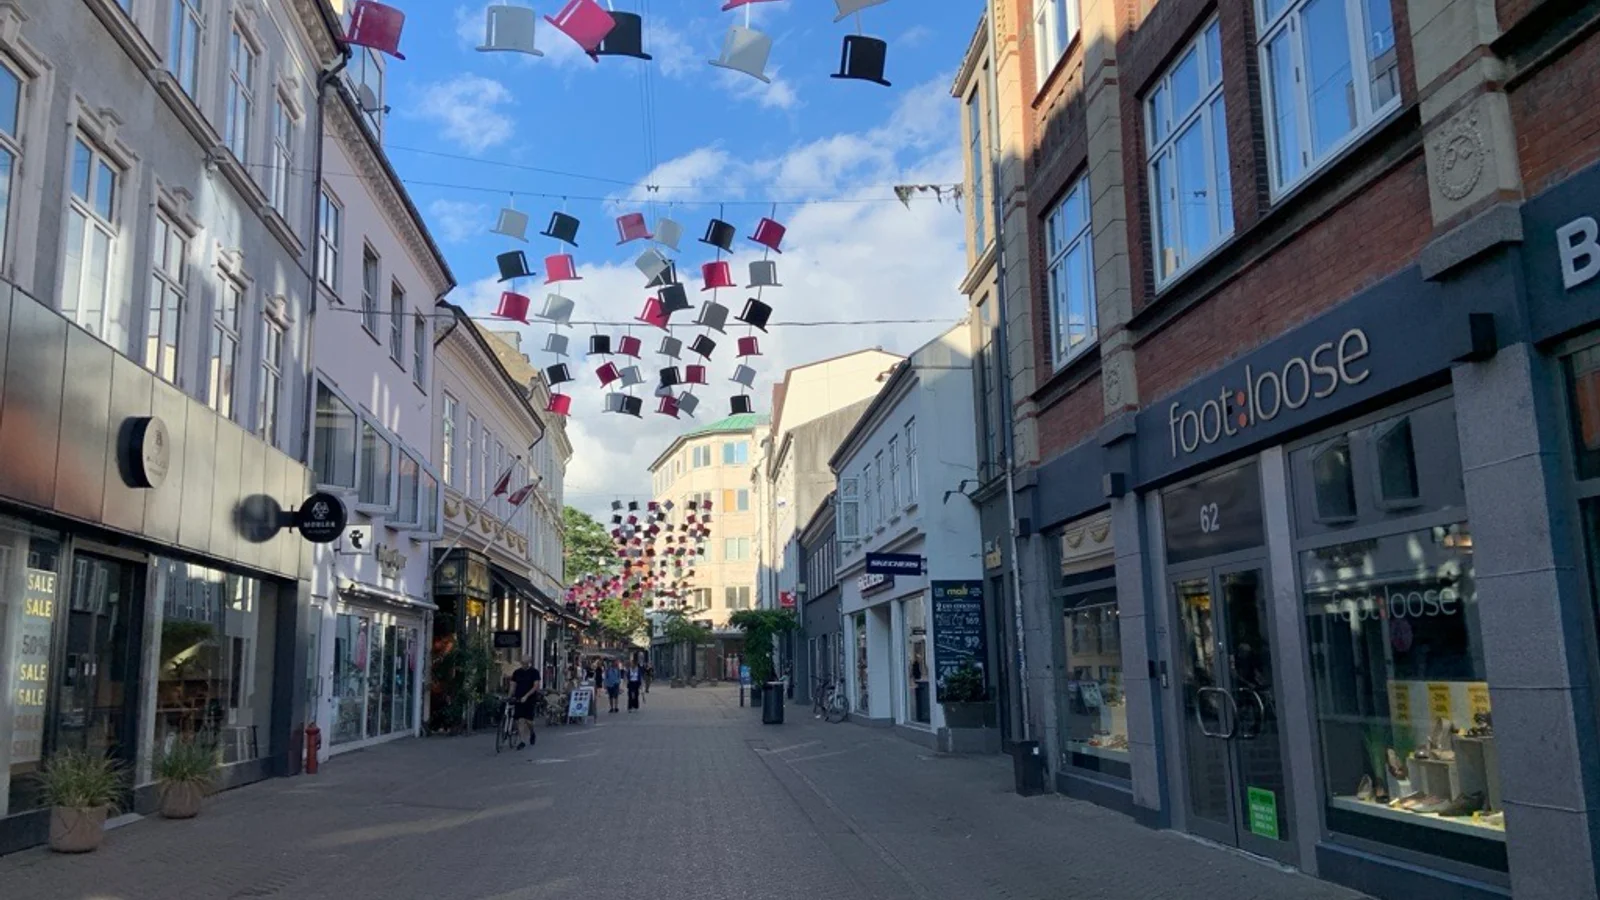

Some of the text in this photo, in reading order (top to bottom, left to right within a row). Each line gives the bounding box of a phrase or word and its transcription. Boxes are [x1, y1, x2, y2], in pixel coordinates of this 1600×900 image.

[1169, 328, 1370, 459] foot:loose
[1200, 502, 1220, 533] 62
[870, 560, 919, 569] SKECHERS
[28, 573, 54, 594] SALE
[25, 598, 52, 617] SALE
[20, 663, 47, 681] SALE
[17, 688, 45, 706] SALE
